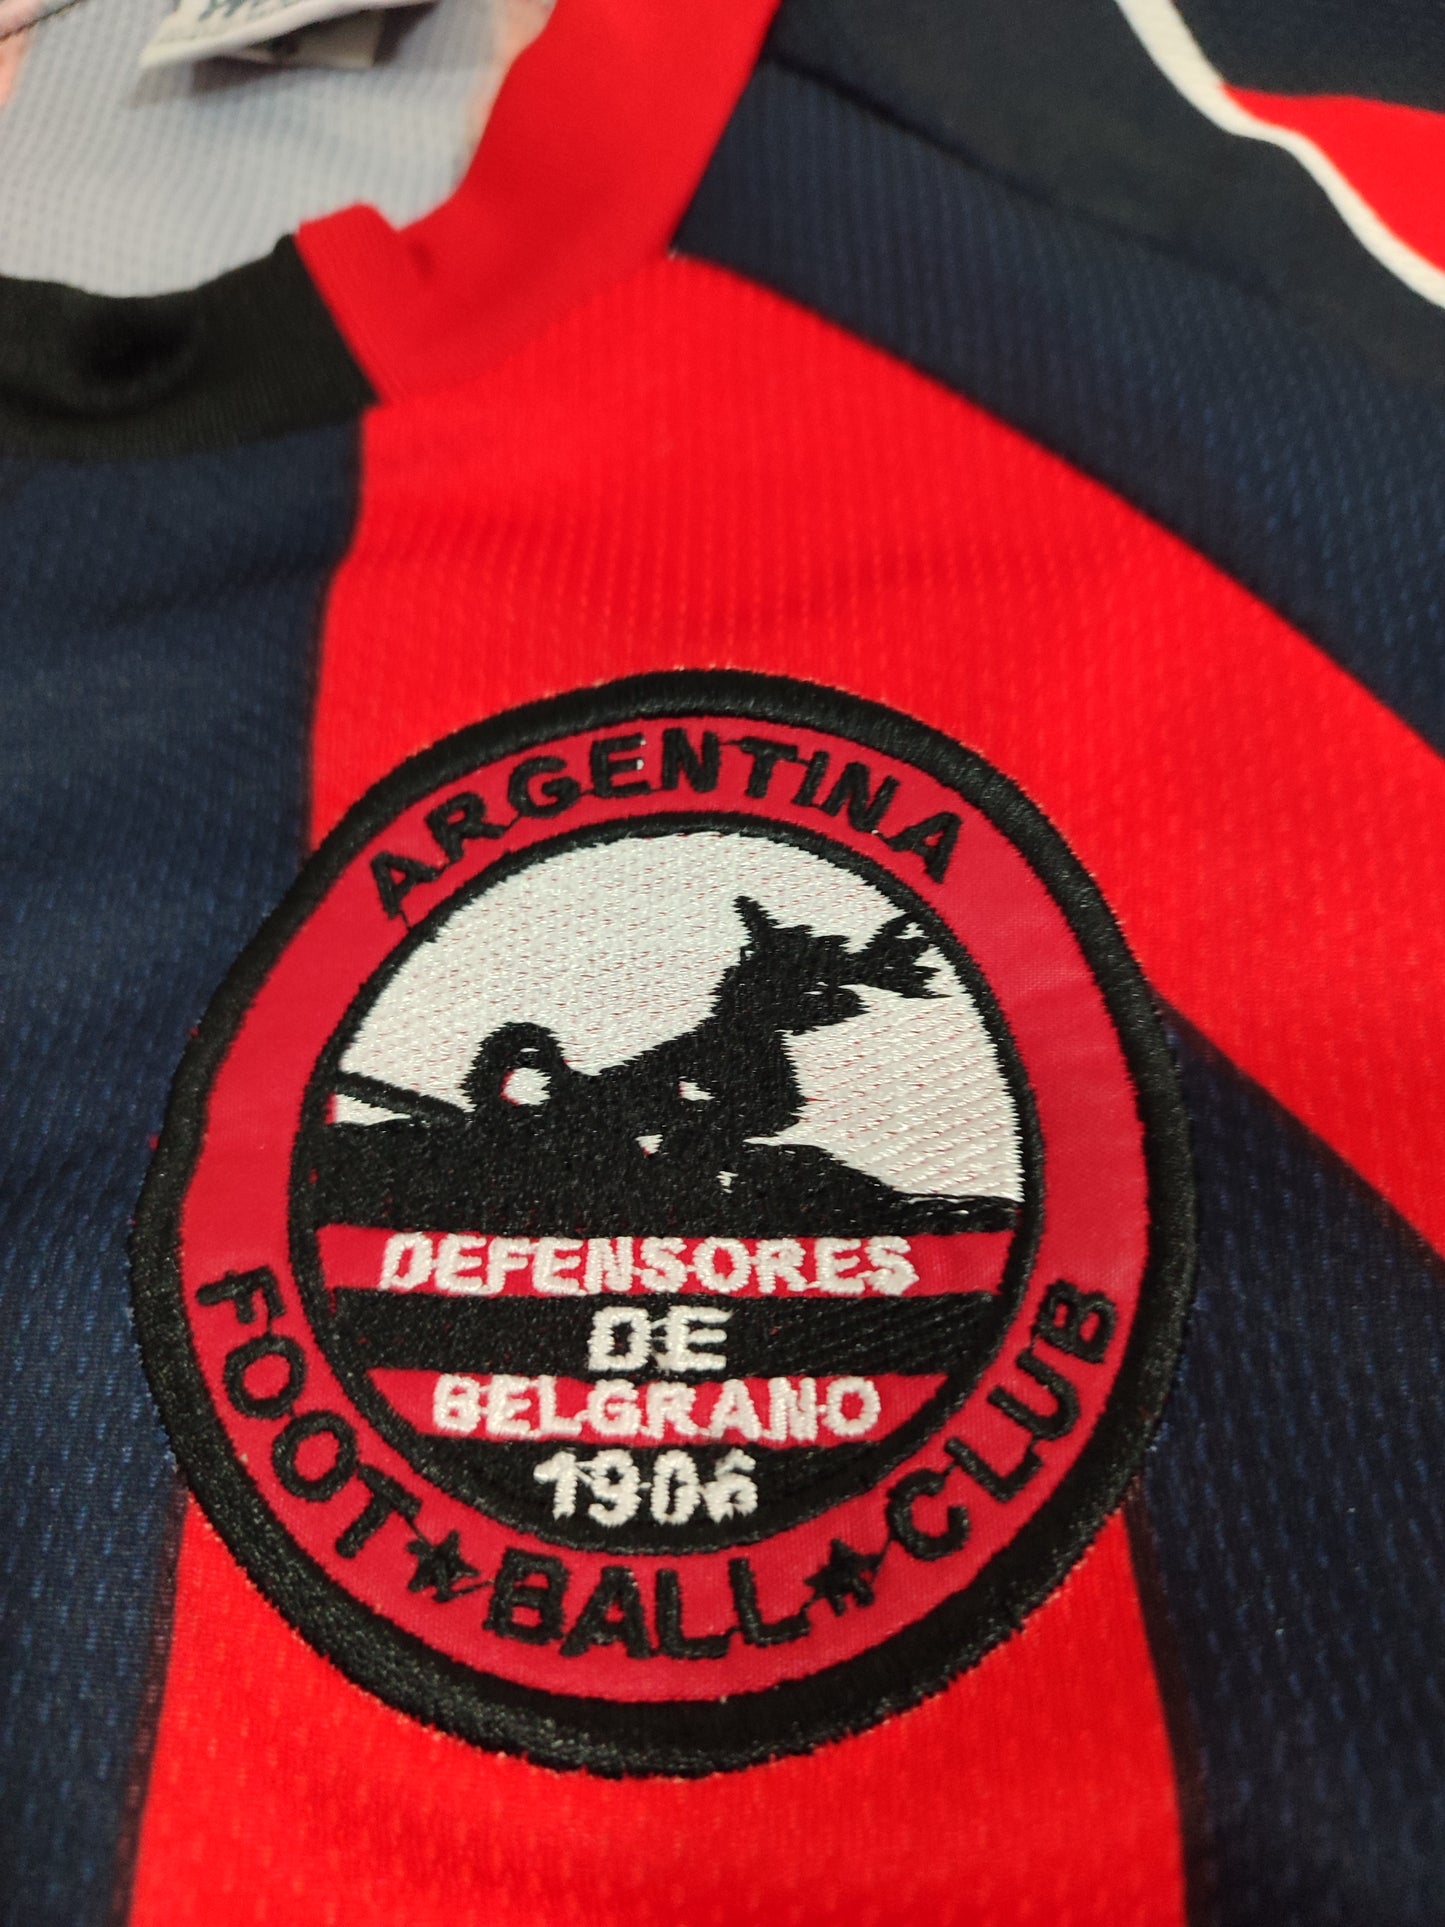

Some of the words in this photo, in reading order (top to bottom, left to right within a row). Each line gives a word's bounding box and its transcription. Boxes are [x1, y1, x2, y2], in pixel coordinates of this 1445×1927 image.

[368, 727, 963, 918] ARGENTINA
[378, 1232, 920, 1296] DEFENSORES
[588, 1305, 733, 1373] DE
[432, 1373, 882, 1441] BELGRANO
[196, 1265, 422, 1559] FOOT
[483, 1547, 810, 1659] BALL
[886, 1279, 1118, 1562] CLUB
[533, 1447, 759, 1528] 1906
